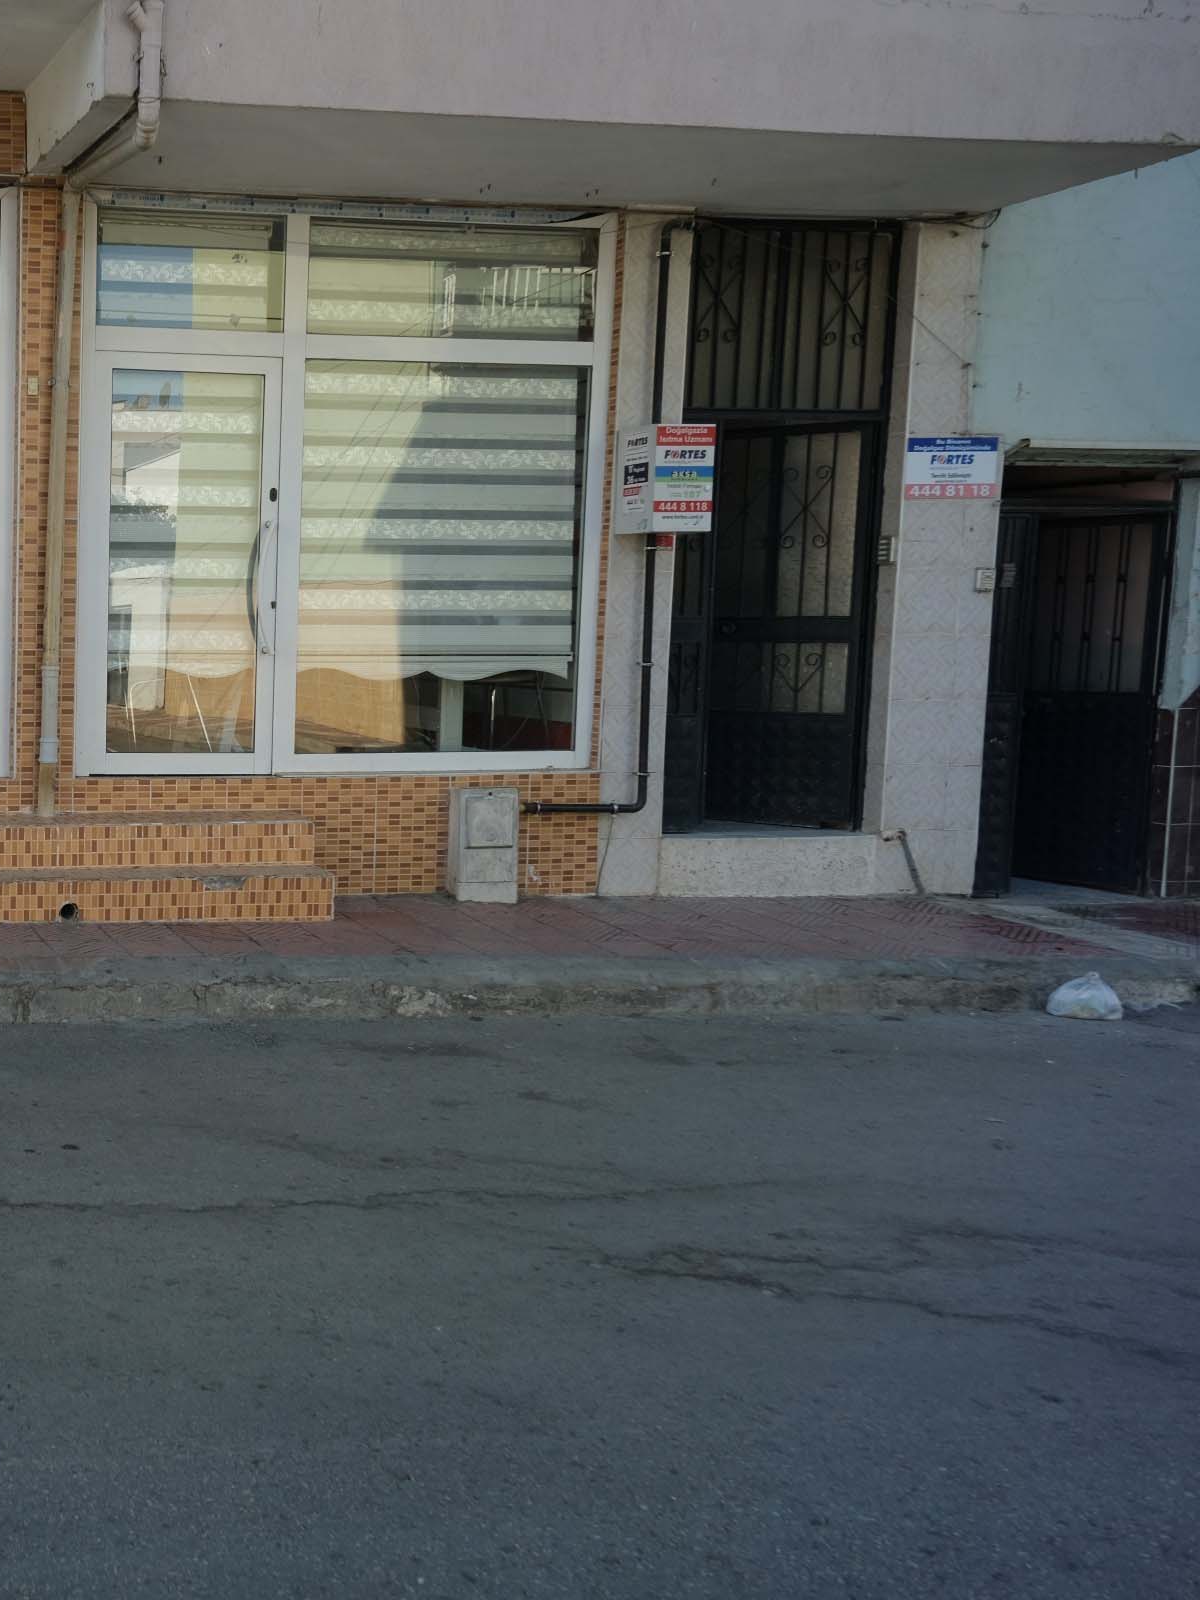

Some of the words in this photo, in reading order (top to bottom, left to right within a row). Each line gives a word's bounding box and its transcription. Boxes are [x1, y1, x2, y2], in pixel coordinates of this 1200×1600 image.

[664, 449, 707, 459] FORTES
[930, 454, 975, 465] FORTES
[911, 485, 941, 497] 444
[944, 485, 965, 497] 81
[972, 485, 991, 497] 18
[658, 502, 678, 511] 444
[679, 502, 687, 511] 8
[689, 502, 708, 511] 118
